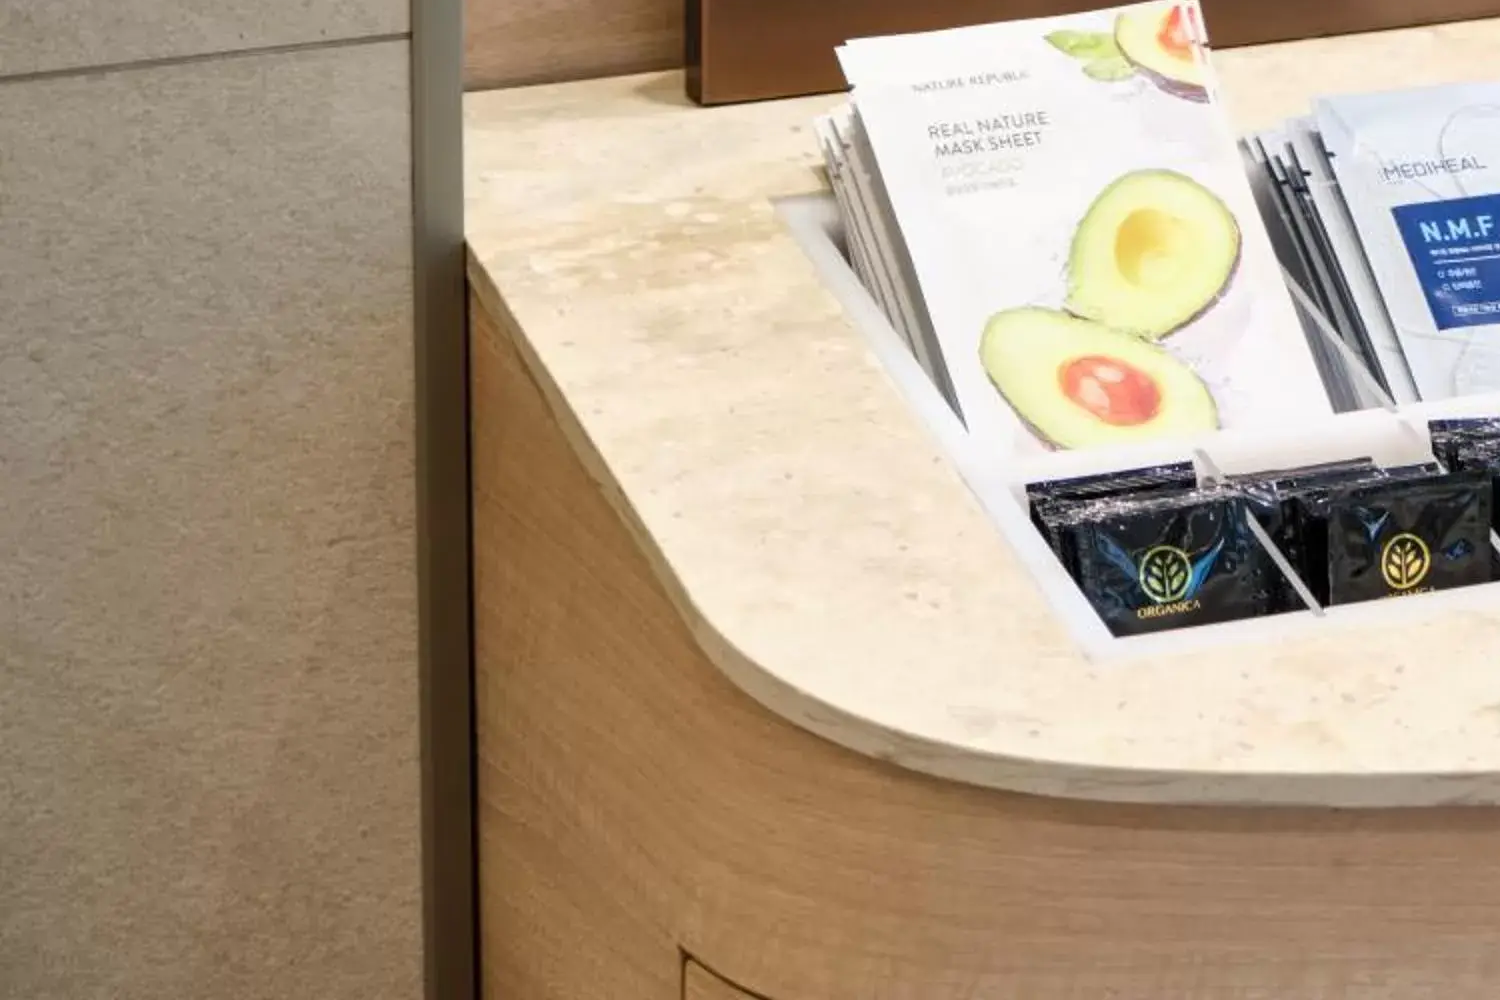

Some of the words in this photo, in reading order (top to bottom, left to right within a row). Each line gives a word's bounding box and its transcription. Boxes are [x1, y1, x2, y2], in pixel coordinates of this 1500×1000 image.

[911, 77, 964, 92] NATURE
[969, 69, 1030, 86] REPUBLIC
[927, 121, 974, 141] REAL
[976, 110, 1051, 133] NATURE
[934, 139, 985, 159] MASK
[988, 131, 1042, 152] SHEET
[1382, 155, 1488, 181] MEDIHEAL
[1419, 214, 1494, 243] N.M.F
[1136, 598, 1202, 619] ORGANICA
